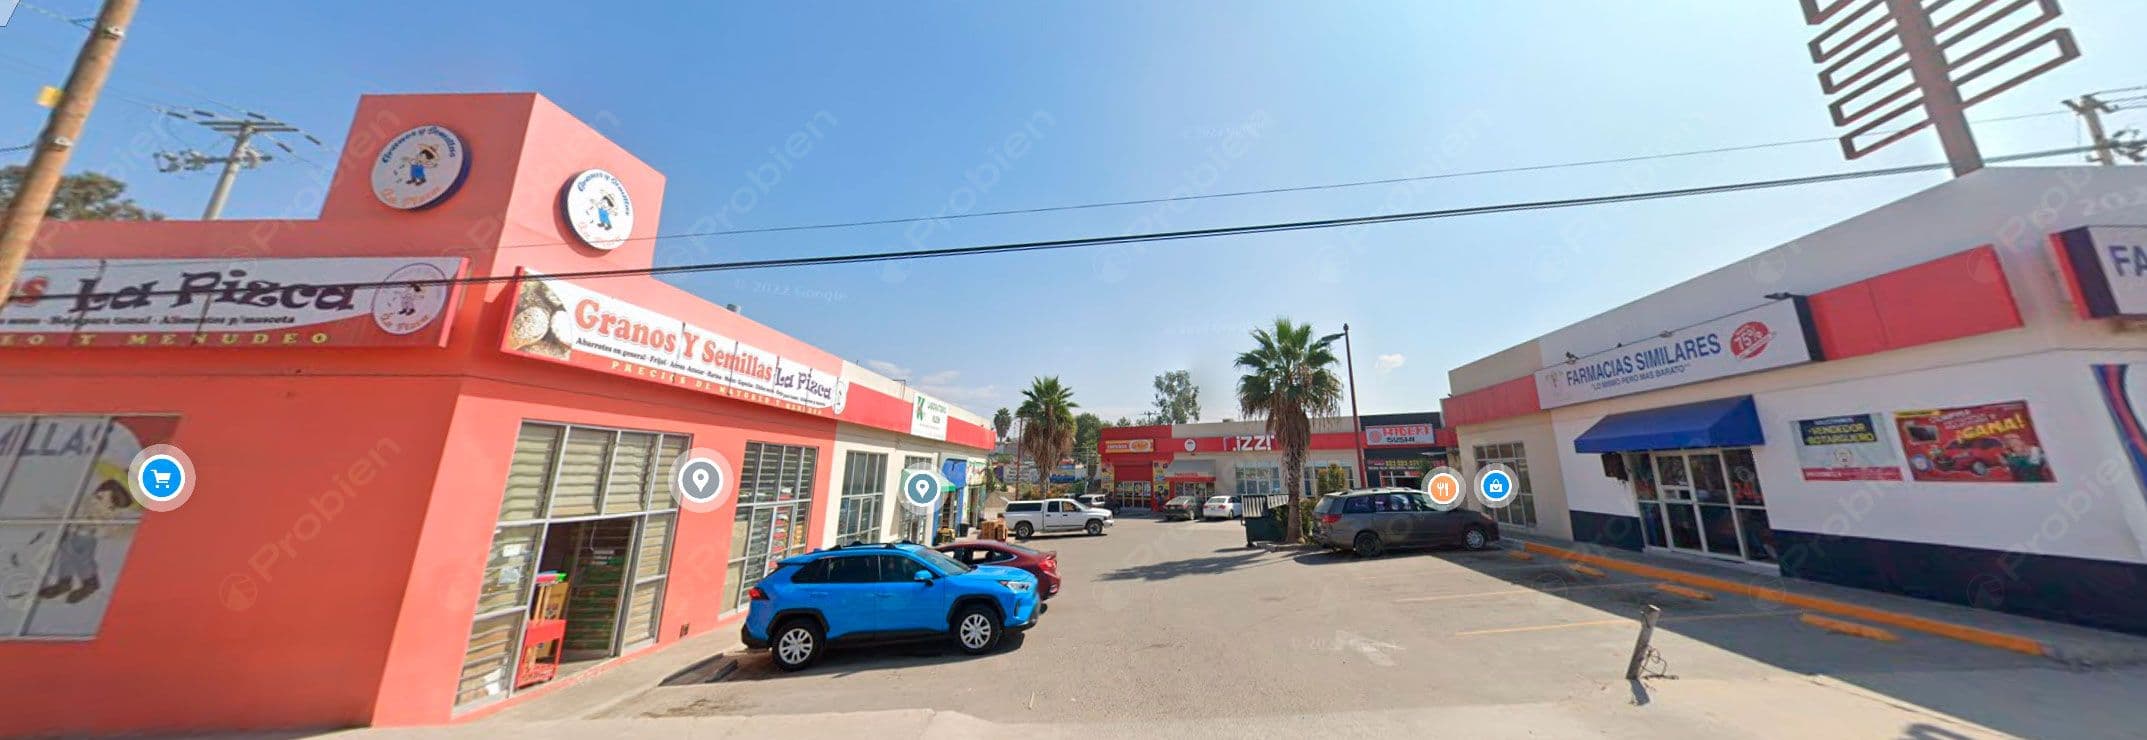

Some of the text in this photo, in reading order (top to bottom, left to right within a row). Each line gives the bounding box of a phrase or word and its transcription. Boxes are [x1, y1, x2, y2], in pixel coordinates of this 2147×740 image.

[67, 278, 158, 313] La
[169, 268, 358, 311] Pizca
[127, 332, 328, 346] MENUDEO
[575, 297, 677, 353] Granos
[683, 331, 700, 358] Y
[702, 338, 773, 382] Semillas
[775, 367, 794, 389] La
[797, 369, 832, 400] Pizca
[1566, 355, 1634, 386] FARMACIAS
[1635, 333, 1722, 371] SIMILARES
[611, 360, 687, 384] PRECIOS
